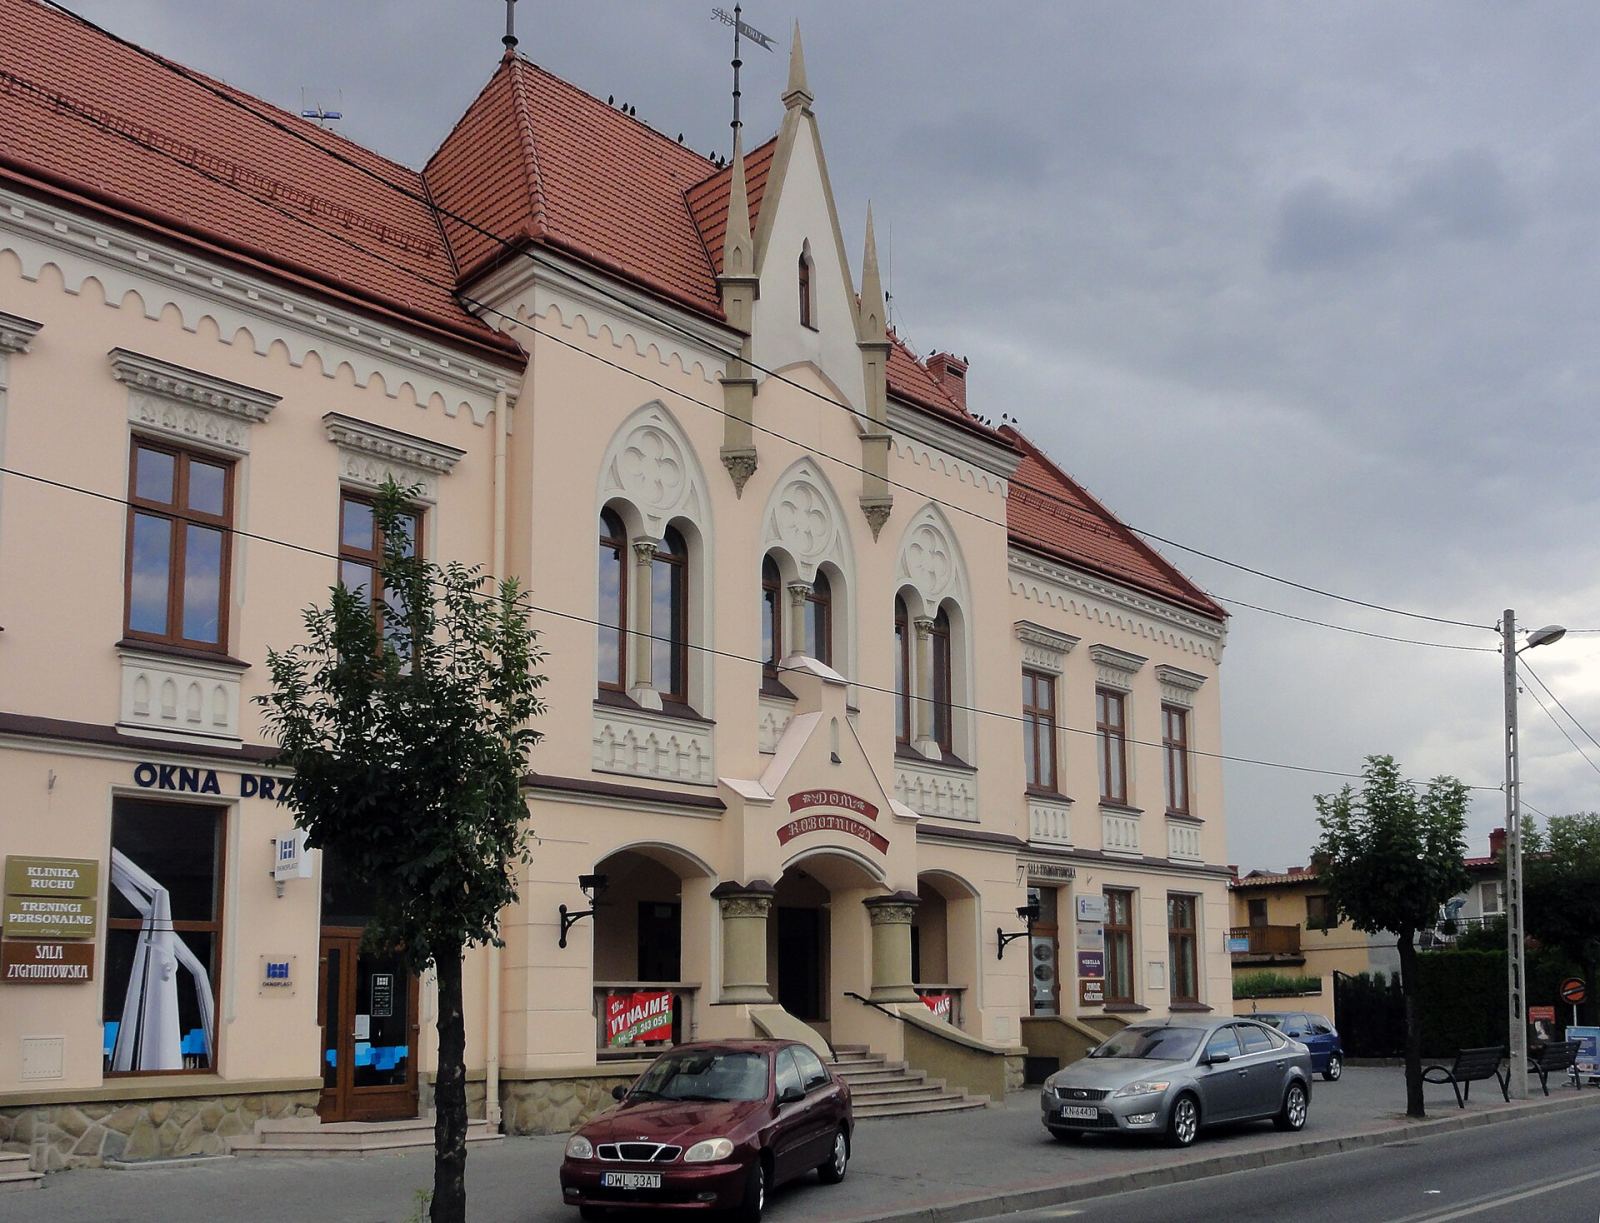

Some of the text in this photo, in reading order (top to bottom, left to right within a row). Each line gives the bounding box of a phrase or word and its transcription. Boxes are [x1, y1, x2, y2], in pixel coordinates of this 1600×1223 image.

[133, 762, 306, 802] OKNA DRZ
[812, 792, 856, 809] DOM
[788, 816, 875, 842] ROBOTNICZY
[27, 866, 80, 878] KLINIKA
[1017, 865, 1025, 888] 7
[30, 878, 75, 889] RUCHU
[20, 902, 83, 913] TRENINGI
[9, 913, 94, 925] PERSONALNE
[35, 945, 64, 960] SALA
[7, 964, 89, 979] ZYGMUNTOWSKA
[653, 1014, 667, 1027] 051
[607, 1173, 659, 1187] DWL 33AT
